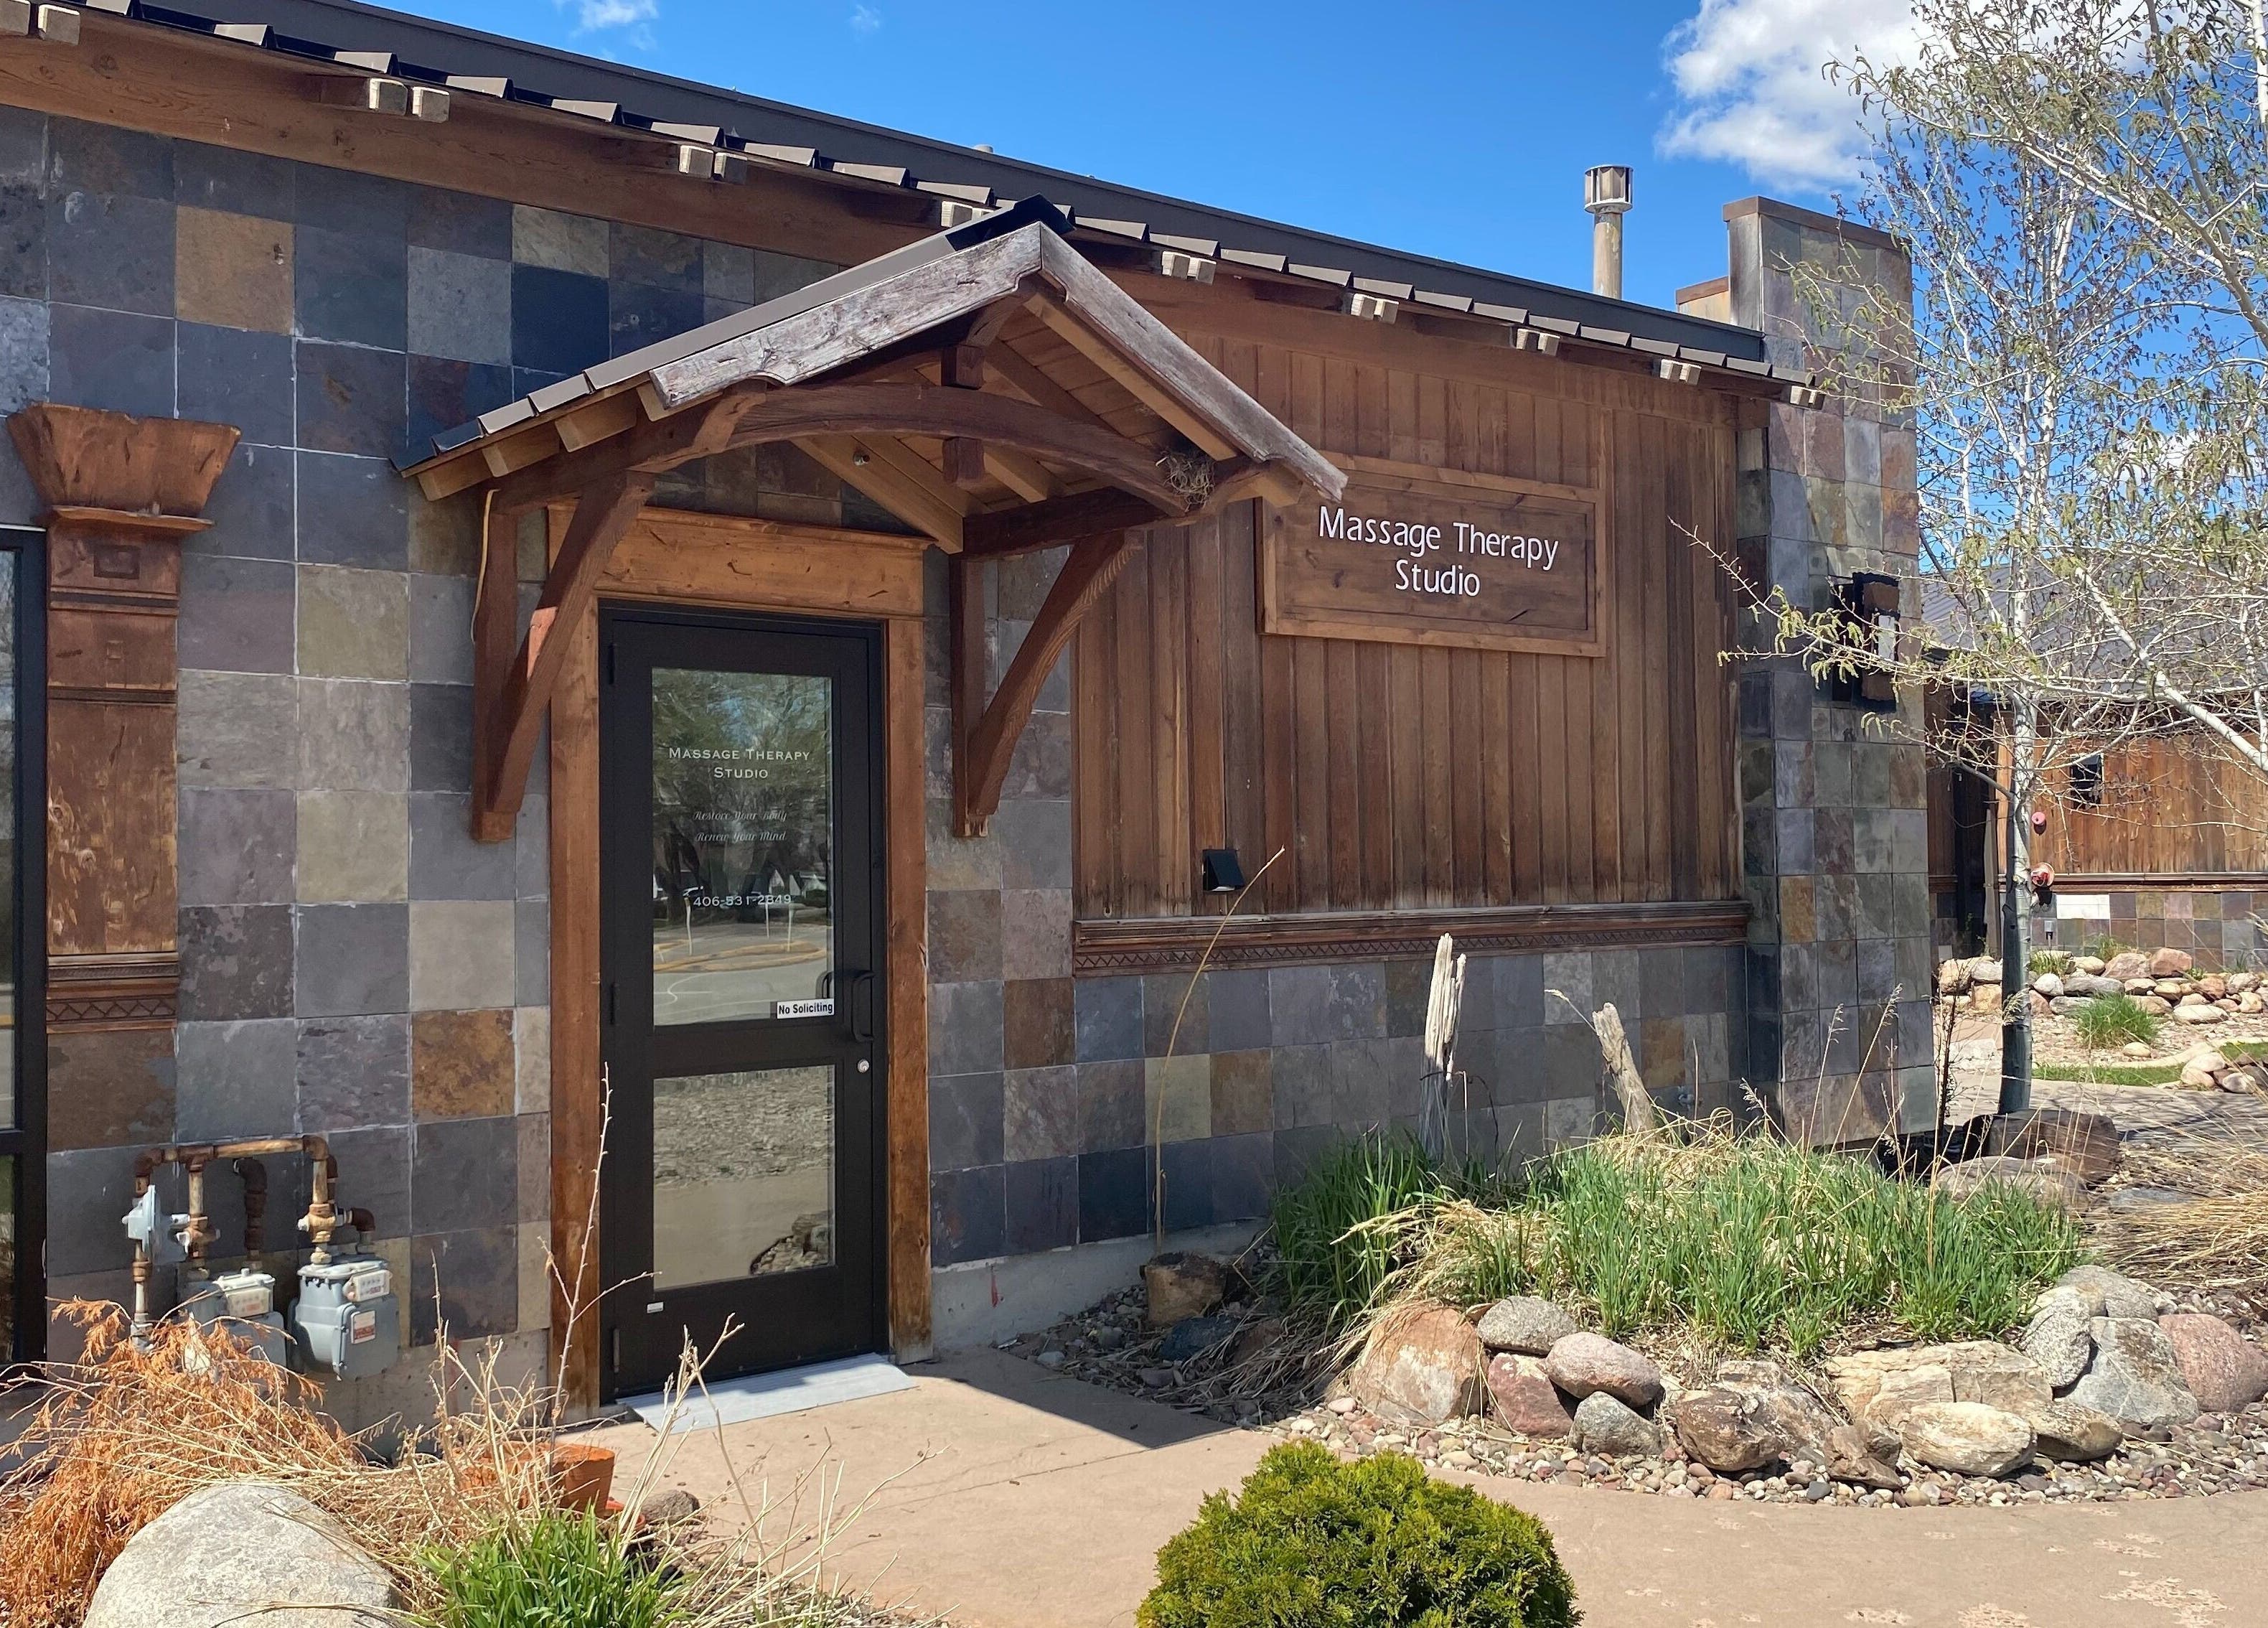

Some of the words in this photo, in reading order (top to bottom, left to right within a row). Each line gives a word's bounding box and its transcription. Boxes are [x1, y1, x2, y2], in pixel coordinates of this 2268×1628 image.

[1318, 505, 1441, 558] Massage
[1453, 521, 1559, 571] Therapy
[1395, 558, 1481, 597] Studio
[693, 810, 730, 820] Restore
[732, 810, 757, 822] Your
[695, 832, 729, 841] Renew
[732, 832, 756, 843] Your
[779, 1005, 790, 1014] No
[792, 1002, 833, 1014] Soliciting
